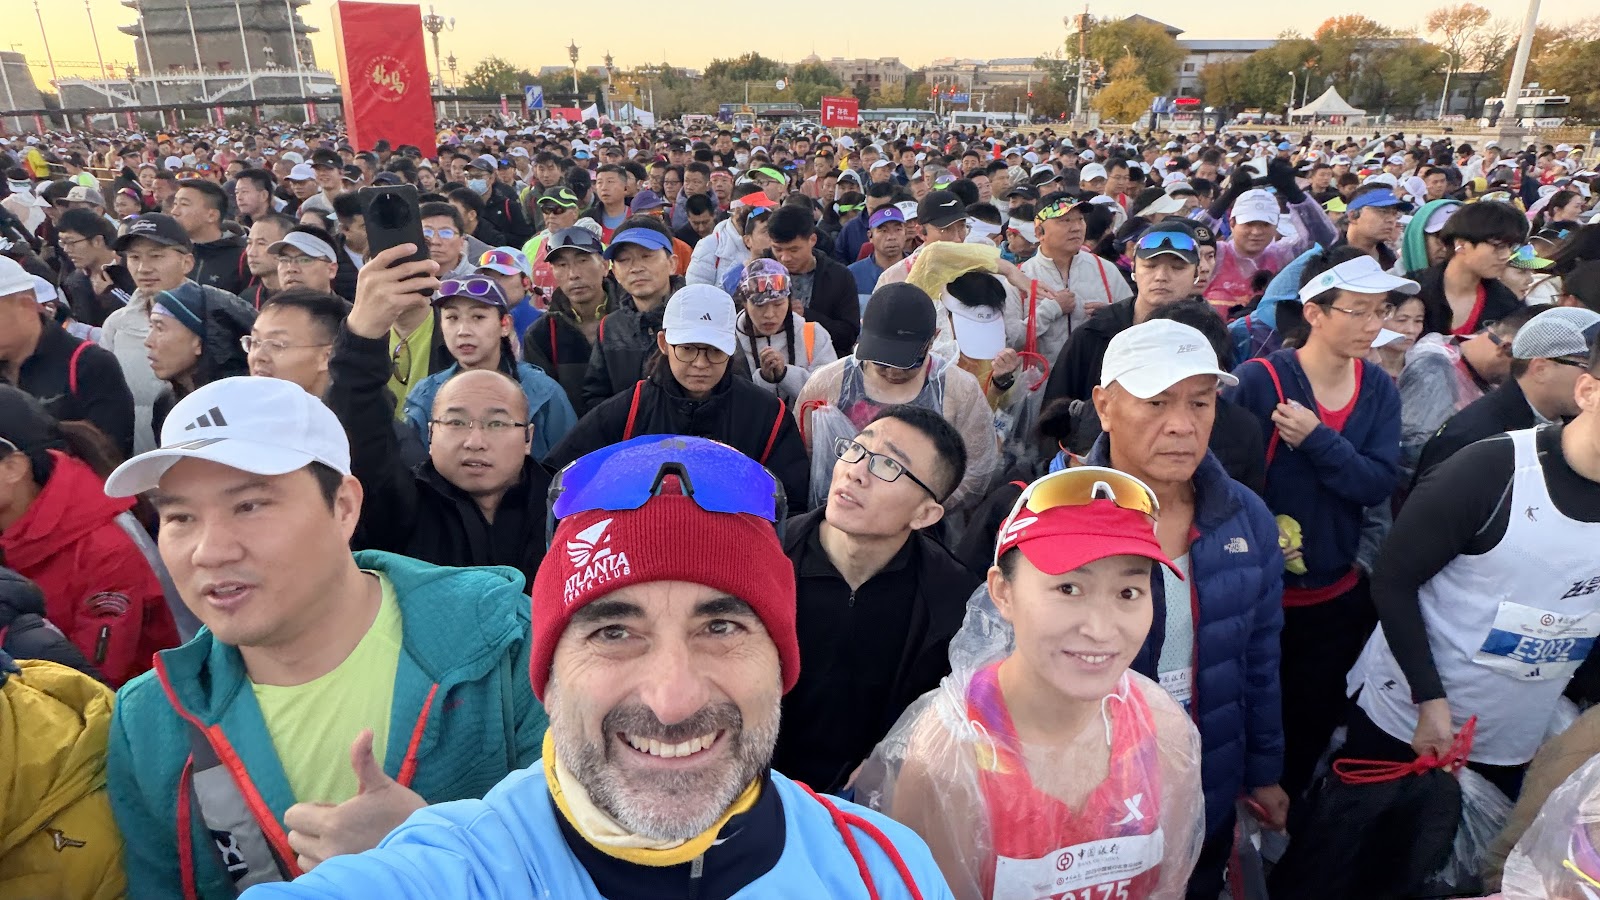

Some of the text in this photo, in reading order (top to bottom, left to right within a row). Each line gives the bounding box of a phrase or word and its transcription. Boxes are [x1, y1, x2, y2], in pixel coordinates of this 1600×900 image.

[372, 64, 405, 95] 北马
[826, 105, 835, 120] F
[564, 552, 629, 597] ATLANTA
[564, 566, 630, 606] TRACK CLUB
[1513, 637, 1576, 658] E3032
